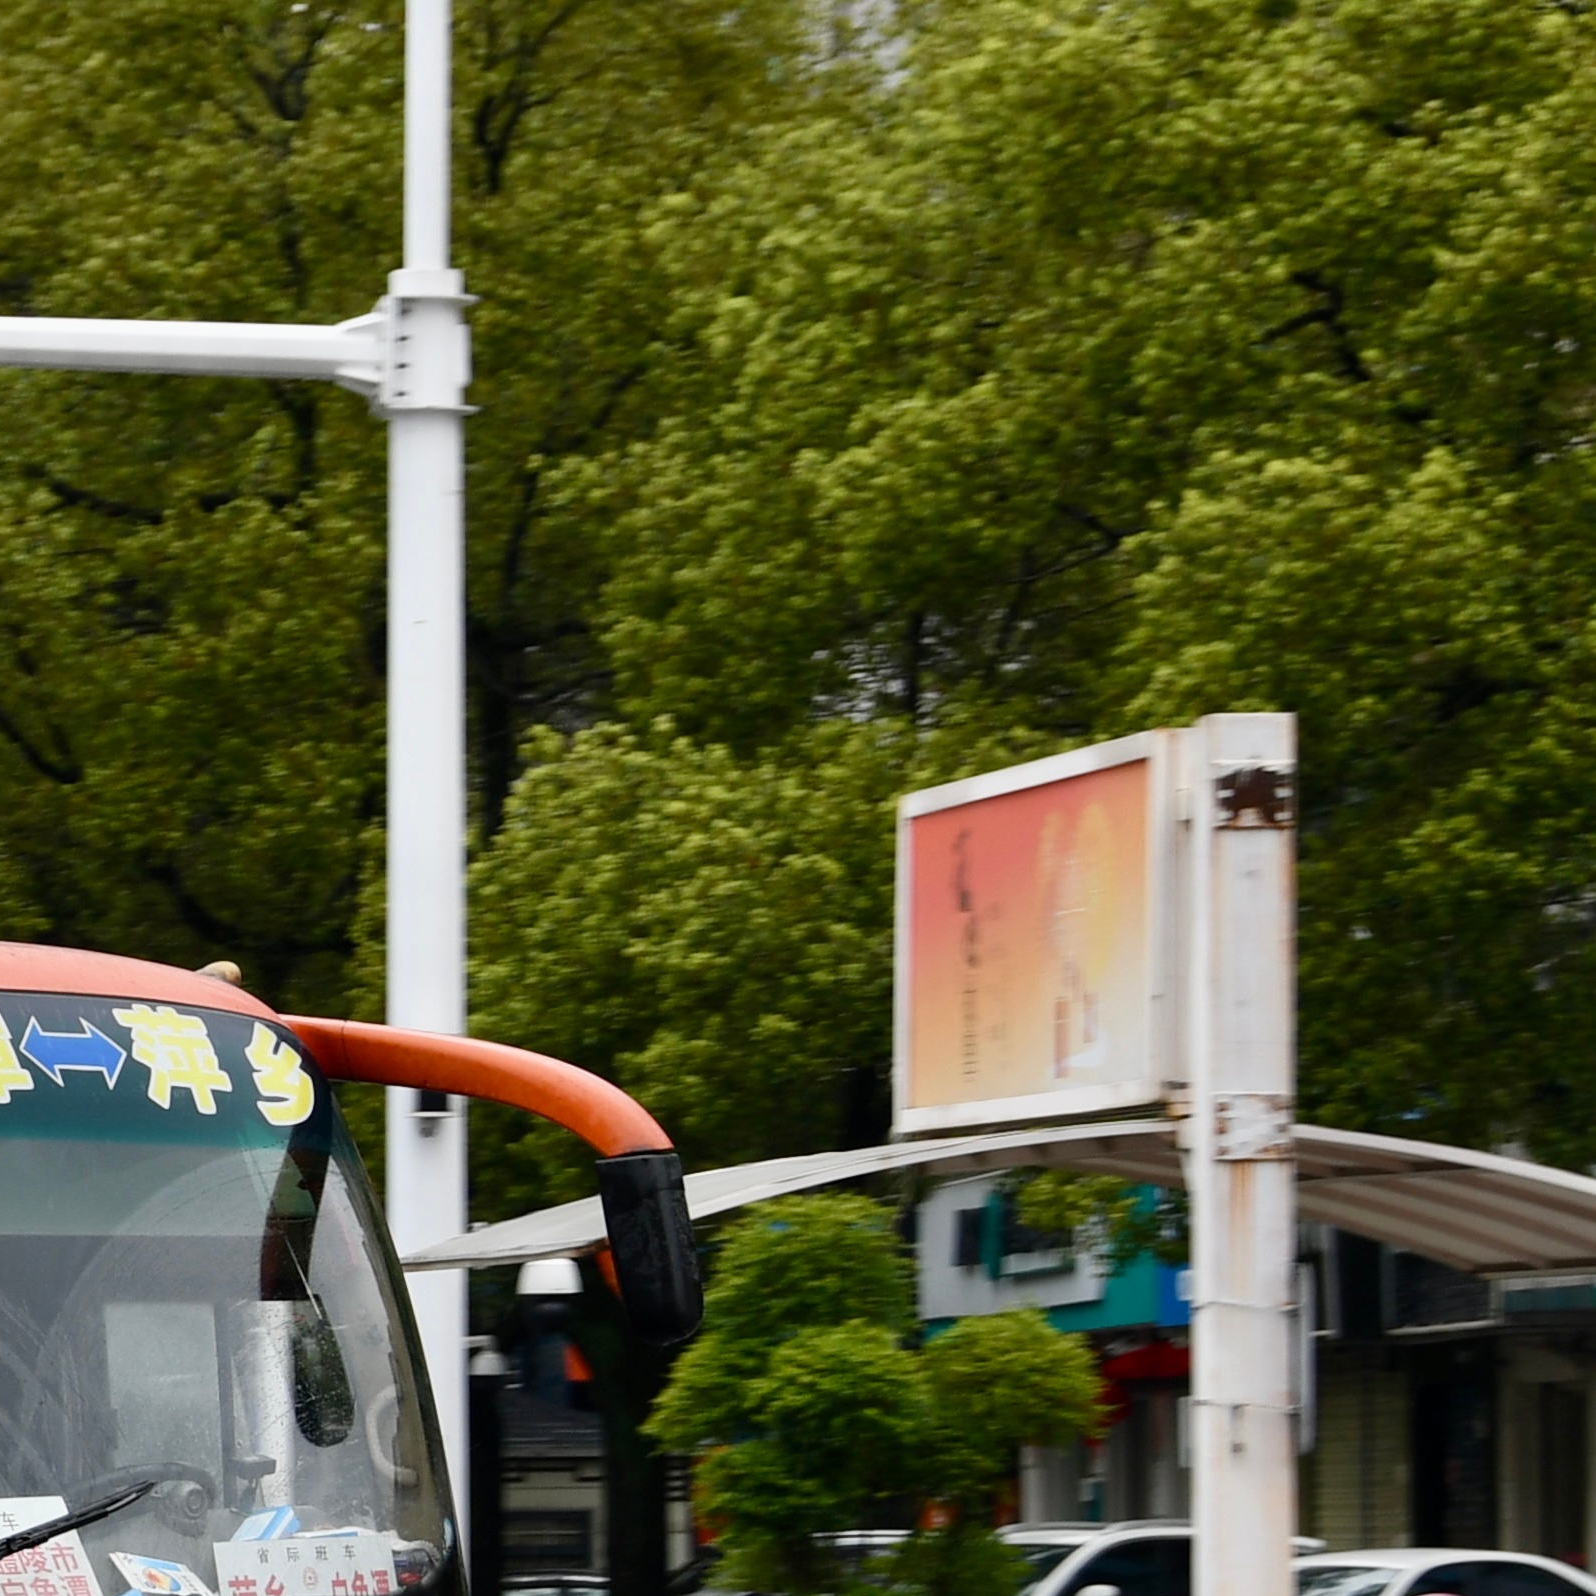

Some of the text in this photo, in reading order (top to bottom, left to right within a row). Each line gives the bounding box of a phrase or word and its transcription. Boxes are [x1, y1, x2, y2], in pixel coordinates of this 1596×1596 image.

[111, 1002, 316, 1127] 萍乡
[257, 1543, 357, 1565] 省际班车
